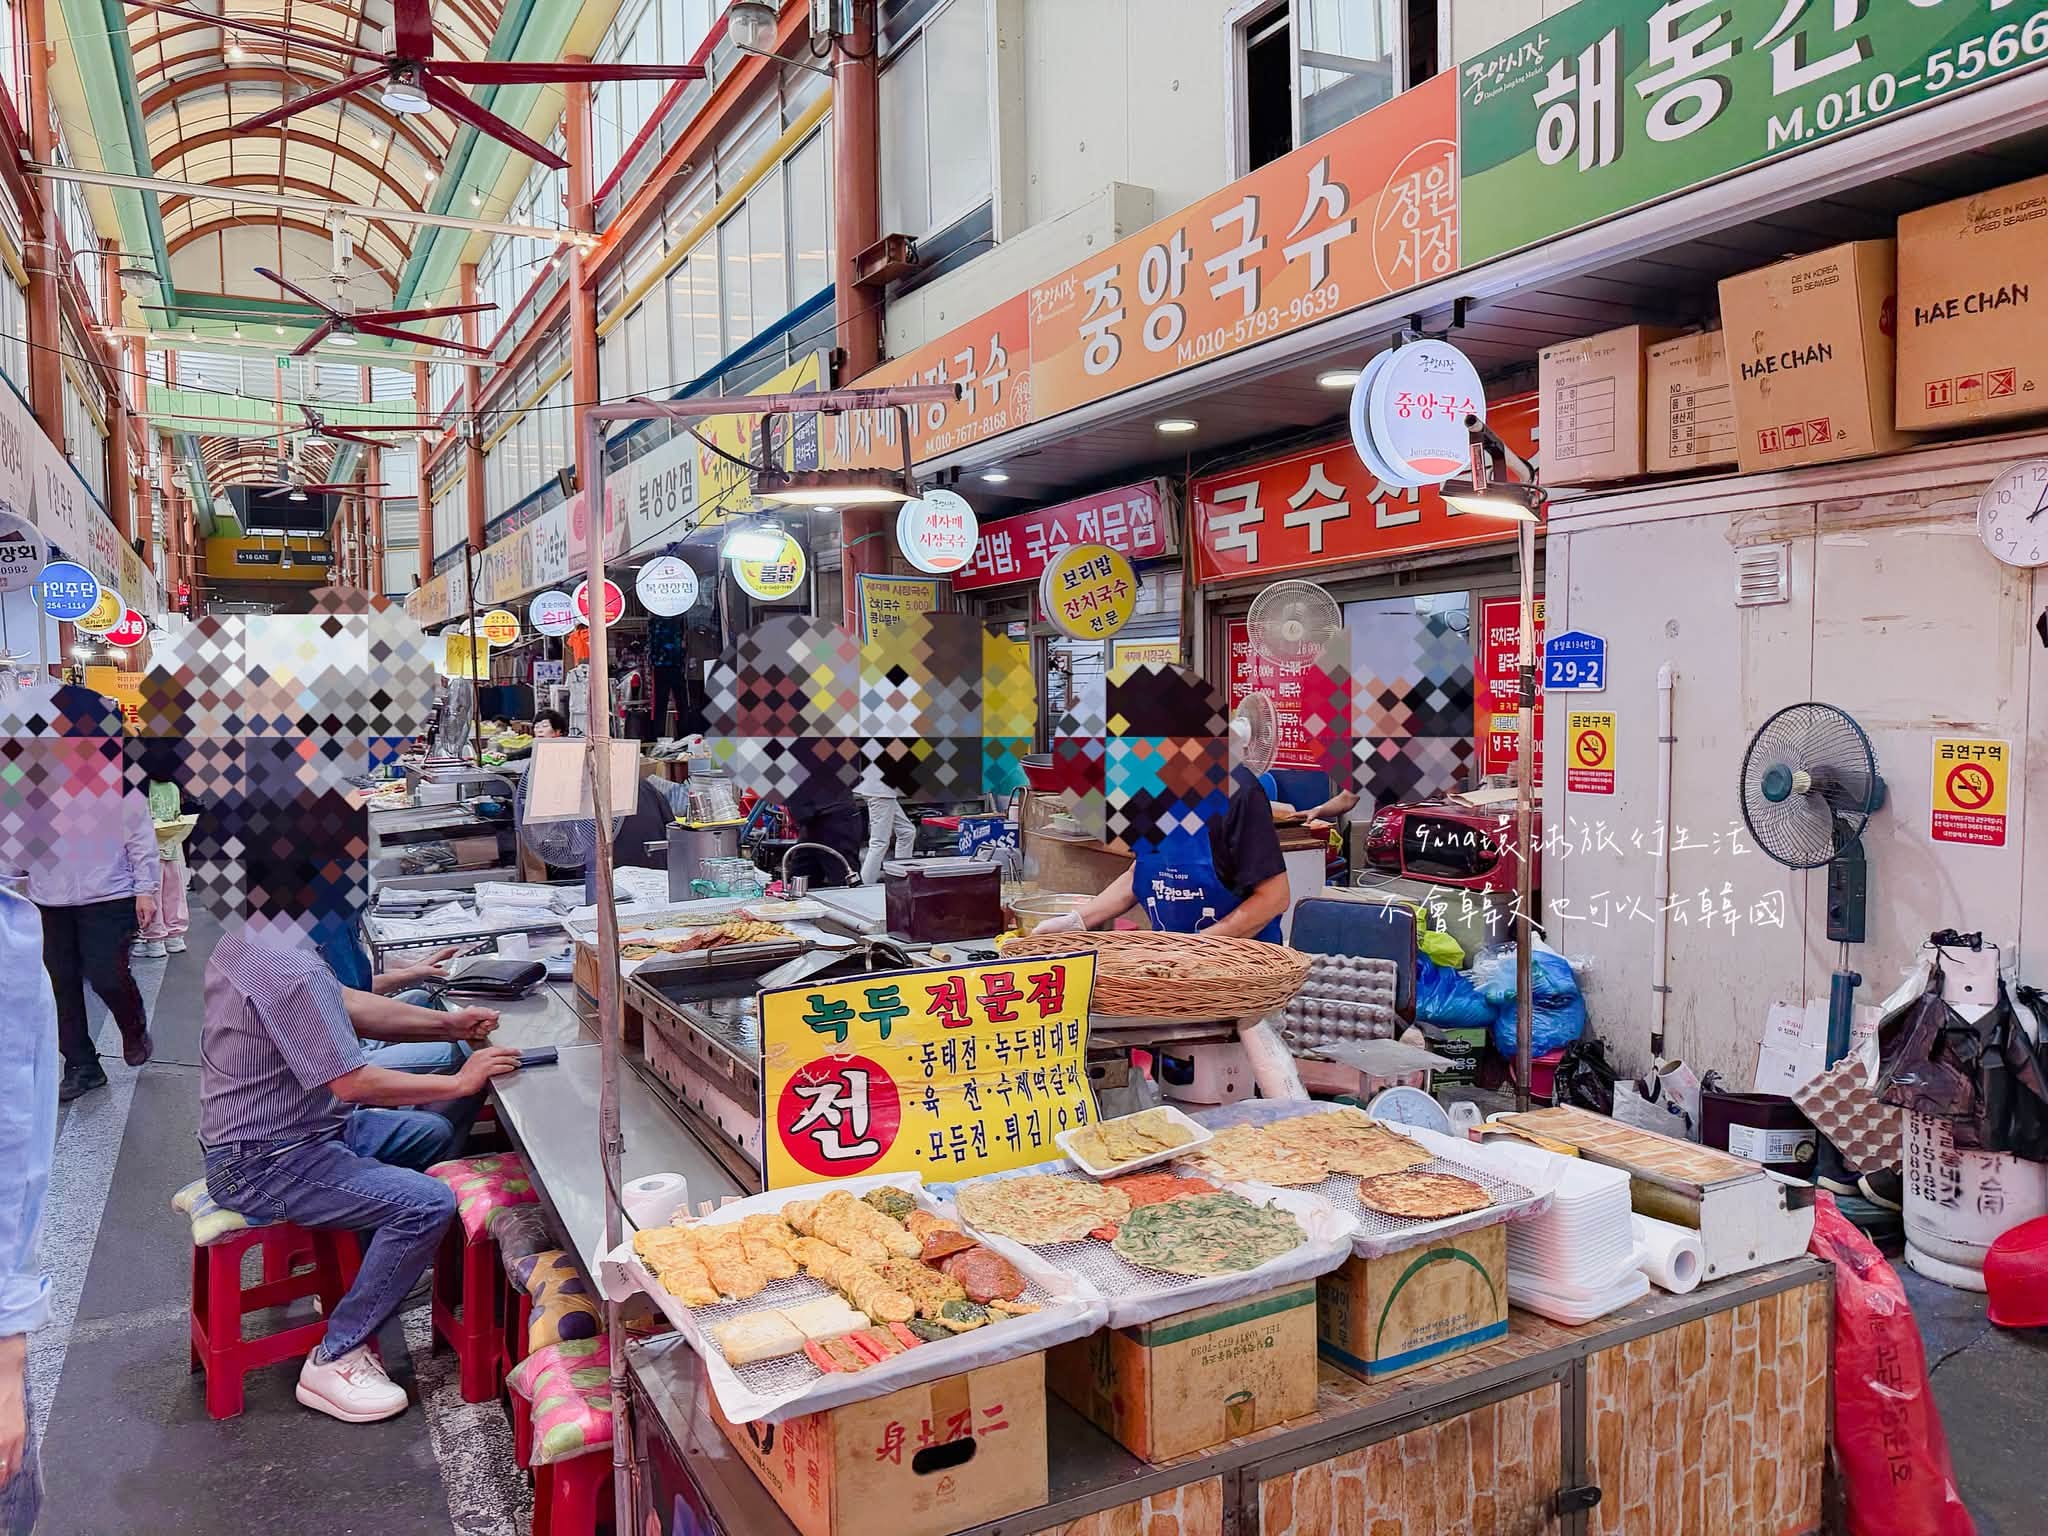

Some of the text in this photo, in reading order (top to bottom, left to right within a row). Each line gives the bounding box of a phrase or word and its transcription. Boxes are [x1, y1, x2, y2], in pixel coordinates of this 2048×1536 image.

[1463, 33, 1550, 105] 중앙시장
[1767, 10, 2048, 151] M.010-5566
[1380, 151, 1456, 232] 정원
[2003, 205, 2013, 215] IN
[2016, 196, 2047, 211] KOREA
[1974, 208, 2048, 234] DRIED SEAWEED
[1389, 216, 1456, 284] 시장
[1079, 156, 1358, 376] 중앙국수
[1803, 271, 1811, 280] IN
[1813, 264, 1838, 278] KOREA
[1804, 275, 1840, 291] SEAWEED
[1914, 283, 2029, 327] HAE CHAN
[1177, 283, 1340, 366] M.010-5793-9639
[1740, 354, 1778, 381] HAE
[1781, 342, 1833, 369] CHAN
[1670, 383, 1681, 393] NO
[1393, 391, 1478, 423] 중앙국수
[1672, 411, 1694, 425] 생산지
[2012, 475, 2024, 489] 11
[2031, 466, 2047, 482] 12
[1996, 489, 2011, 504] 10
[1988, 509, 1998, 524] 9
[919, 532, 968, 549] 시장국수
[1025, 518, 1069, 569] 국수
[1077, 494, 1156, 548] 전문점
[1994, 527, 2004, 541] 8
[2007, 541, 2018, 557] 7
[2029, 546, 2040, 561] 6
[1062, 554, 1112, 592] 보리밥
[893, 585, 930, 597] 시장국수
[1063, 577, 1129, 620] 잔치국수
[46, 602, 87, 610] 254-1114
[1551, 661, 1599, 682] 29-2
[1572, 715, 1611, 729] 금연구역
[1941, 744, 2001, 761] 금연구역
[802, 965, 1067, 1043] 녹두 전문점
[919, 1018, 1080, 1079] 동태전 녹두빈대떡
[996, 1059, 1082, 1107] 수제떡갈비
[789, 1068, 881, 1161] 전
[928, 1119, 989, 1164] 모듬전
[876, 1403, 1009, 1466] 身土不二
